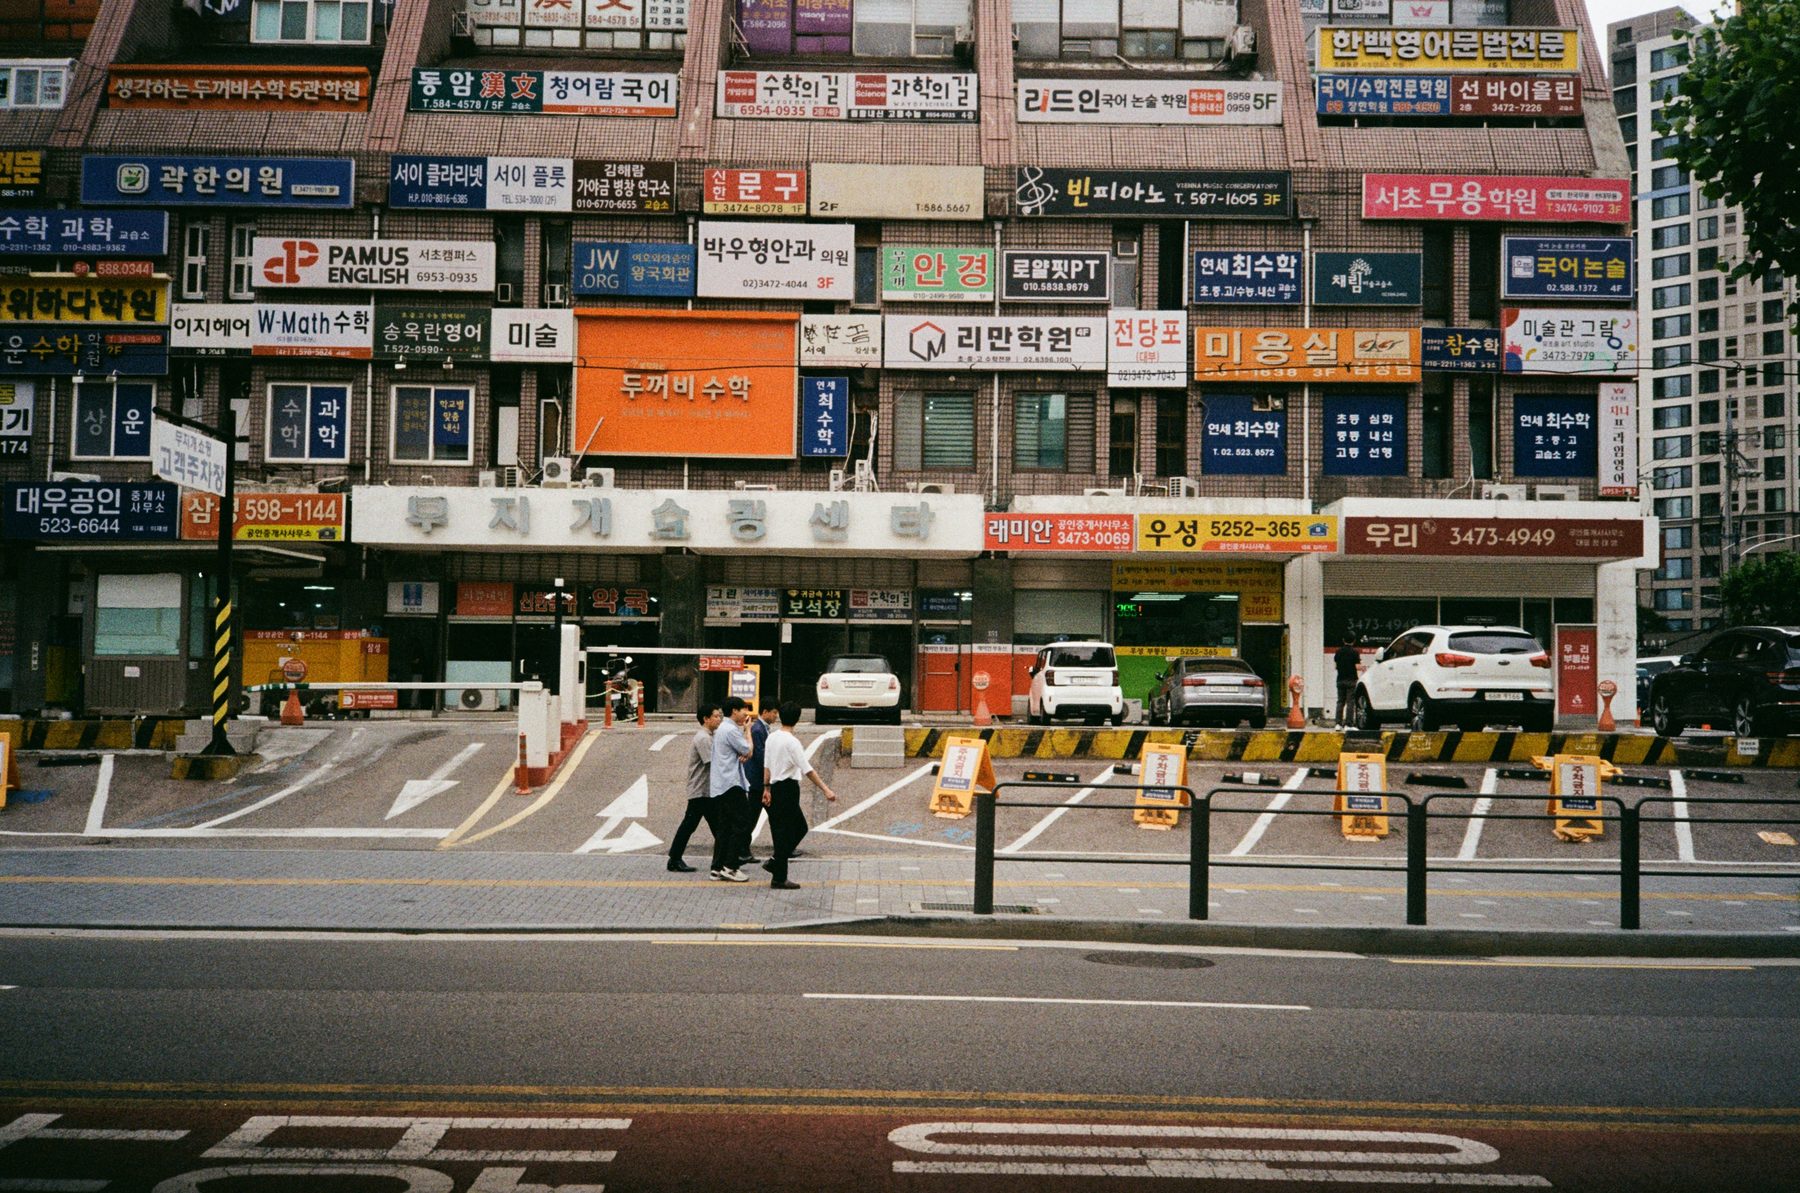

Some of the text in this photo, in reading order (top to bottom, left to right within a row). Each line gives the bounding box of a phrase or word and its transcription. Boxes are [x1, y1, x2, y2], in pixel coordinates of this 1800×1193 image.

[1333, 29, 1565, 60] 한백영어문법전문
[115, 79, 190, 99] 생각하는
[550, 76, 669, 103] 청어람 국어
[1227, 92, 1250, 101] 6959
[1227, 103, 1250, 112] 0959
[1253, 93, 1277, 110] 5F
[740, 105, 805, 116] 6954-0935
[159, 165, 284, 195] 곽한의원
[426, 163, 483, 187] 클라리넷
[819, 202, 839, 212] 2F
[1264, 194, 1280, 205] 3F
[1608, 204, 1622, 214] 3F
[61, 217, 114, 241] 과학
[329, 246, 409, 266] PAMUS
[419, 249, 477, 262] 서초캠퍼스
[584, 249, 620, 271] JW
[704, 237, 849, 266] 박우형안과 의원
[98, 263, 150, 275] 588.0344
[913, 253, 989, 287] 안경
[1201, 258, 1229, 276] 연세
[328, 268, 409, 284] ENGLISH
[416, 272, 478, 283] 6953-0935
[817, 277, 835, 289] 3F
[1610, 284, 1622, 292] 4F
[174, 318, 250, 337] 이지헤어
[509, 323, 558, 348] 미술
[1114, 318, 1181, 348] 전당포
[957, 327, 1072, 352] 리만학원
[1205, 331, 1339, 366] 미용실
[1313, 368, 1336, 377] 3F
[1336, 414, 1393, 425] 초등 심화
[1546, 412, 1590, 429] 최수학
[1208, 421, 1280, 438] 연세 최수학
[1566, 451, 1577, 459] 2F
[16, 488, 121, 515] 대우공인
[130, 502, 165, 513] 사무소
[245, 499, 337, 521] 598-1144
[40, 518, 120, 533] 523-6644
[988, 519, 1054, 543] 래미안
[1057, 519, 1129, 530] 공인중개사사무소
[1145, 519, 1301, 547] 우성 5252-365
[1366, 524, 1417, 548] 우리
[1450, 527, 1555, 545] 3473-4949
